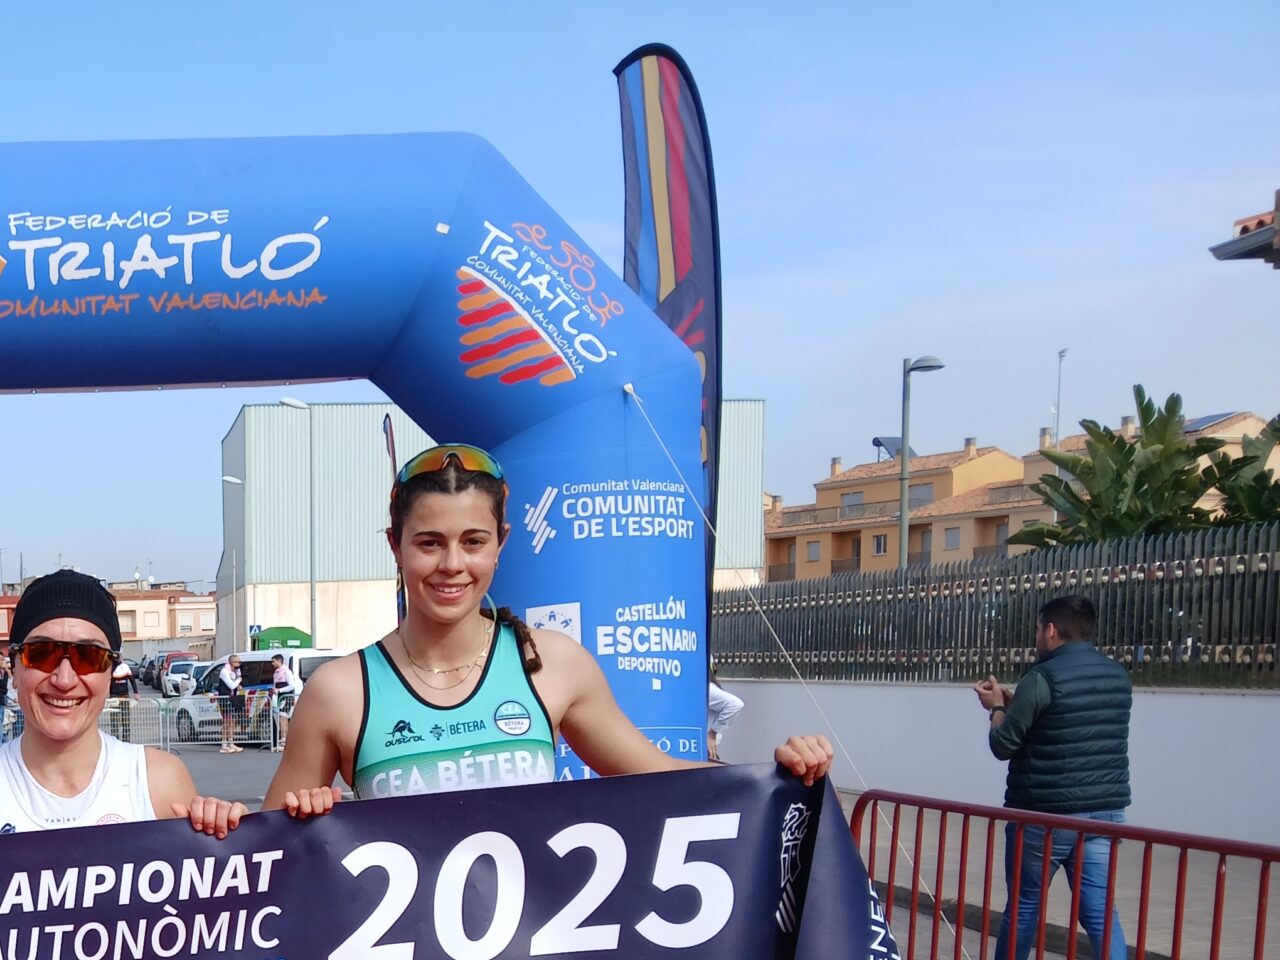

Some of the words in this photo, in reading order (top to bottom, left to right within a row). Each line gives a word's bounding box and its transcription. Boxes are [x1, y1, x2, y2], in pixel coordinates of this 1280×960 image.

[8, 206, 172, 234] FEDERACIÓ
[188, 208, 229, 226] DE
[9, 216, 328, 290] TRIATLÓ
[480, 220, 617, 363] TRIATLÓ
[522, 244, 585, 302] FEDERACIÓ
[581, 304, 598, 322] DE
[149, 288, 327, 314] VALENCIANA
[467, 255, 532, 307] COMUNITAT
[531, 305, 585, 374] VALENCIANA
[563, 480, 629, 495] Comunitat
[631, 479, 685, 493] Valenciana
[562, 496, 685, 518] COMUNITAT
[573, 518, 604, 539] DE
[611, 517, 694, 540] L'ESPORT
[616, 596, 685, 622] CASTELLÓN
[597, 626, 697, 655] ESCENARIO
[617, 656, 681, 677] DEPORTIVO
[449, 720, 486, 735] BÉTERA
[679, 739, 697, 753] DE
[372, 766, 428, 797] CEA
[437, 750, 549, 790] BÉTERA
